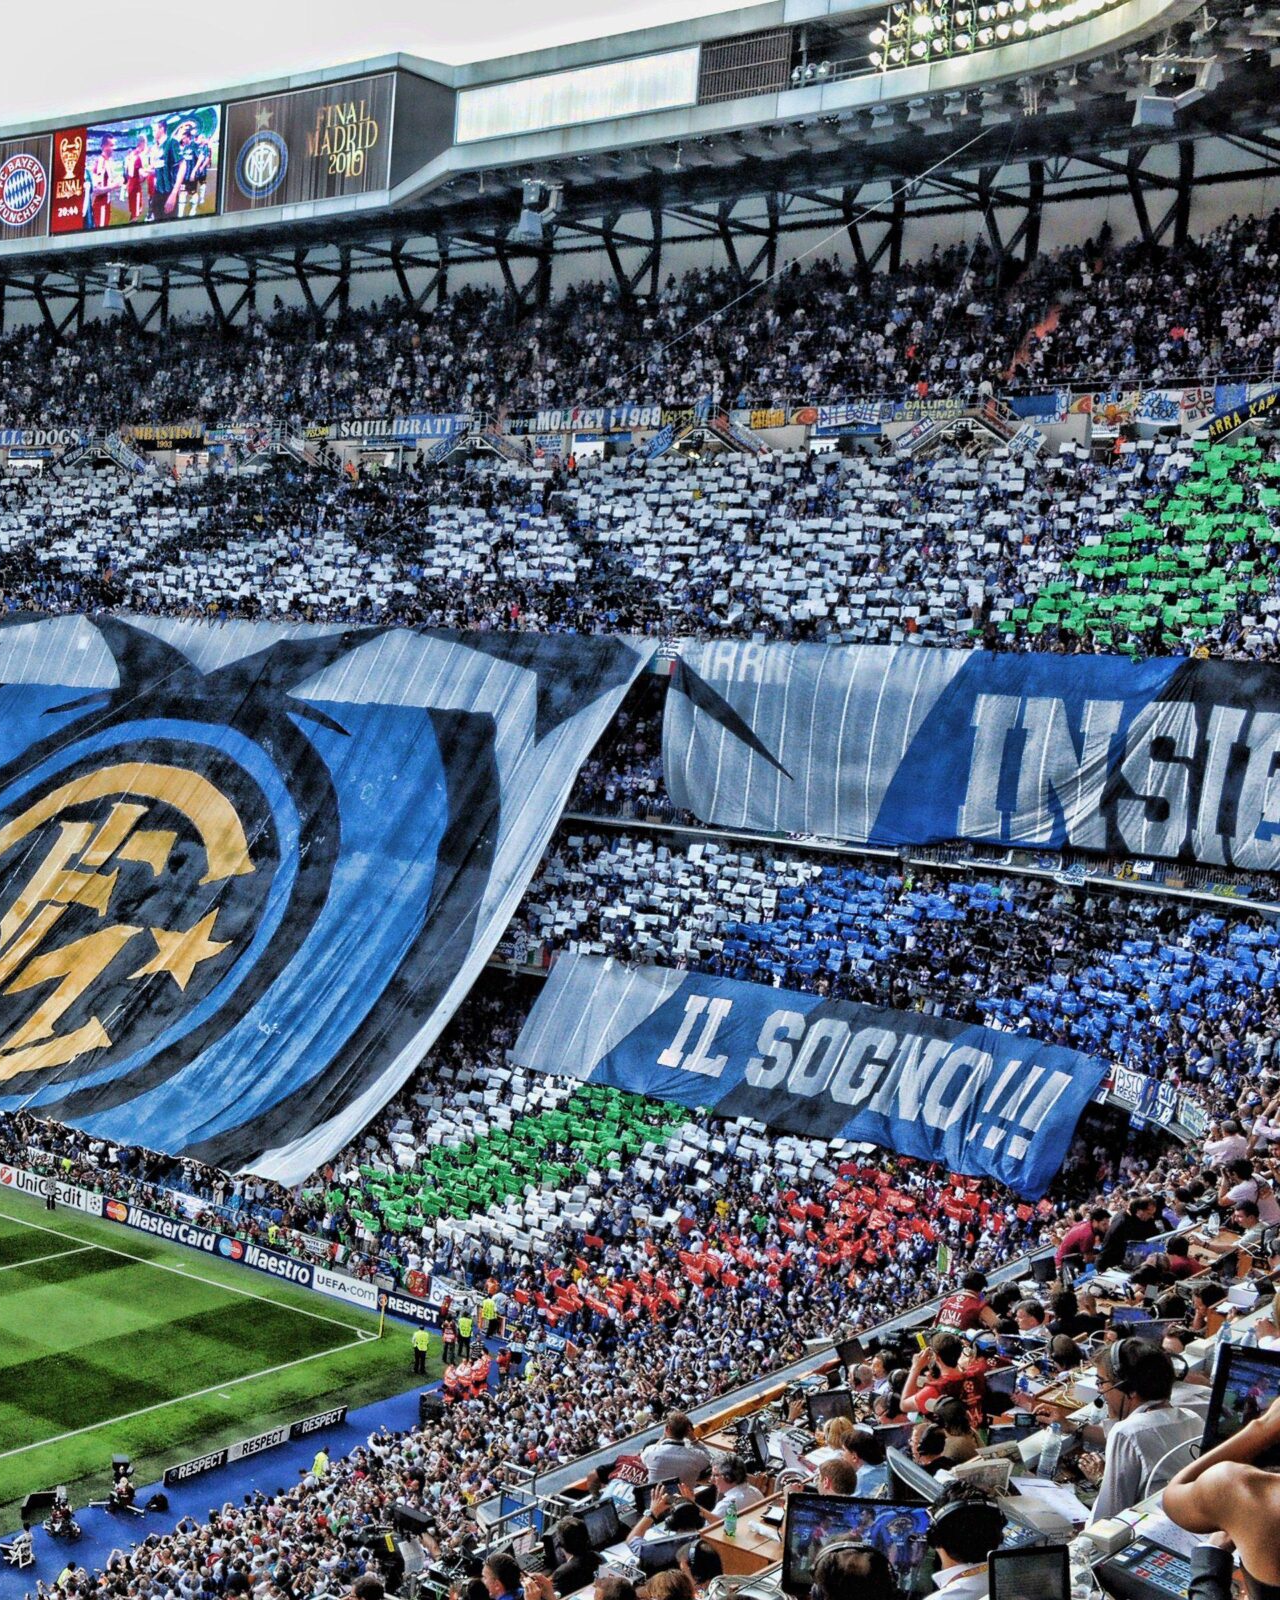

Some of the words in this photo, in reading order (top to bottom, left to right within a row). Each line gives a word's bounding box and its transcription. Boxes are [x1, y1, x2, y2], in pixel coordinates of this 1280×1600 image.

[317, 100, 370, 128] FINAL
[306, 119, 379, 157] MADRID
[8, 157, 44, 183] BAYERN
[329, 148, 365, 178] 2010
[340, 417, 452, 438] SQUILIBRATI
[620, 406, 662, 428] 1988
[33, 429, 81, 447] DOGS
[657, 994, 733, 1078] IL
[745, 1009, 1073, 1160] SOGNO!!!
[16, 1173, 83, 1207] UniCedit
[128, 1206, 216, 1243] MasterCard
[244, 1244, 312, 1285] Maestro
[389, 1298, 440, 1324] RESPECT
[301, 1408, 344, 1434] RESPECT
[241, 1428, 285, 1456] RESPECT
[177, 1451, 225, 1480] RESPECT
